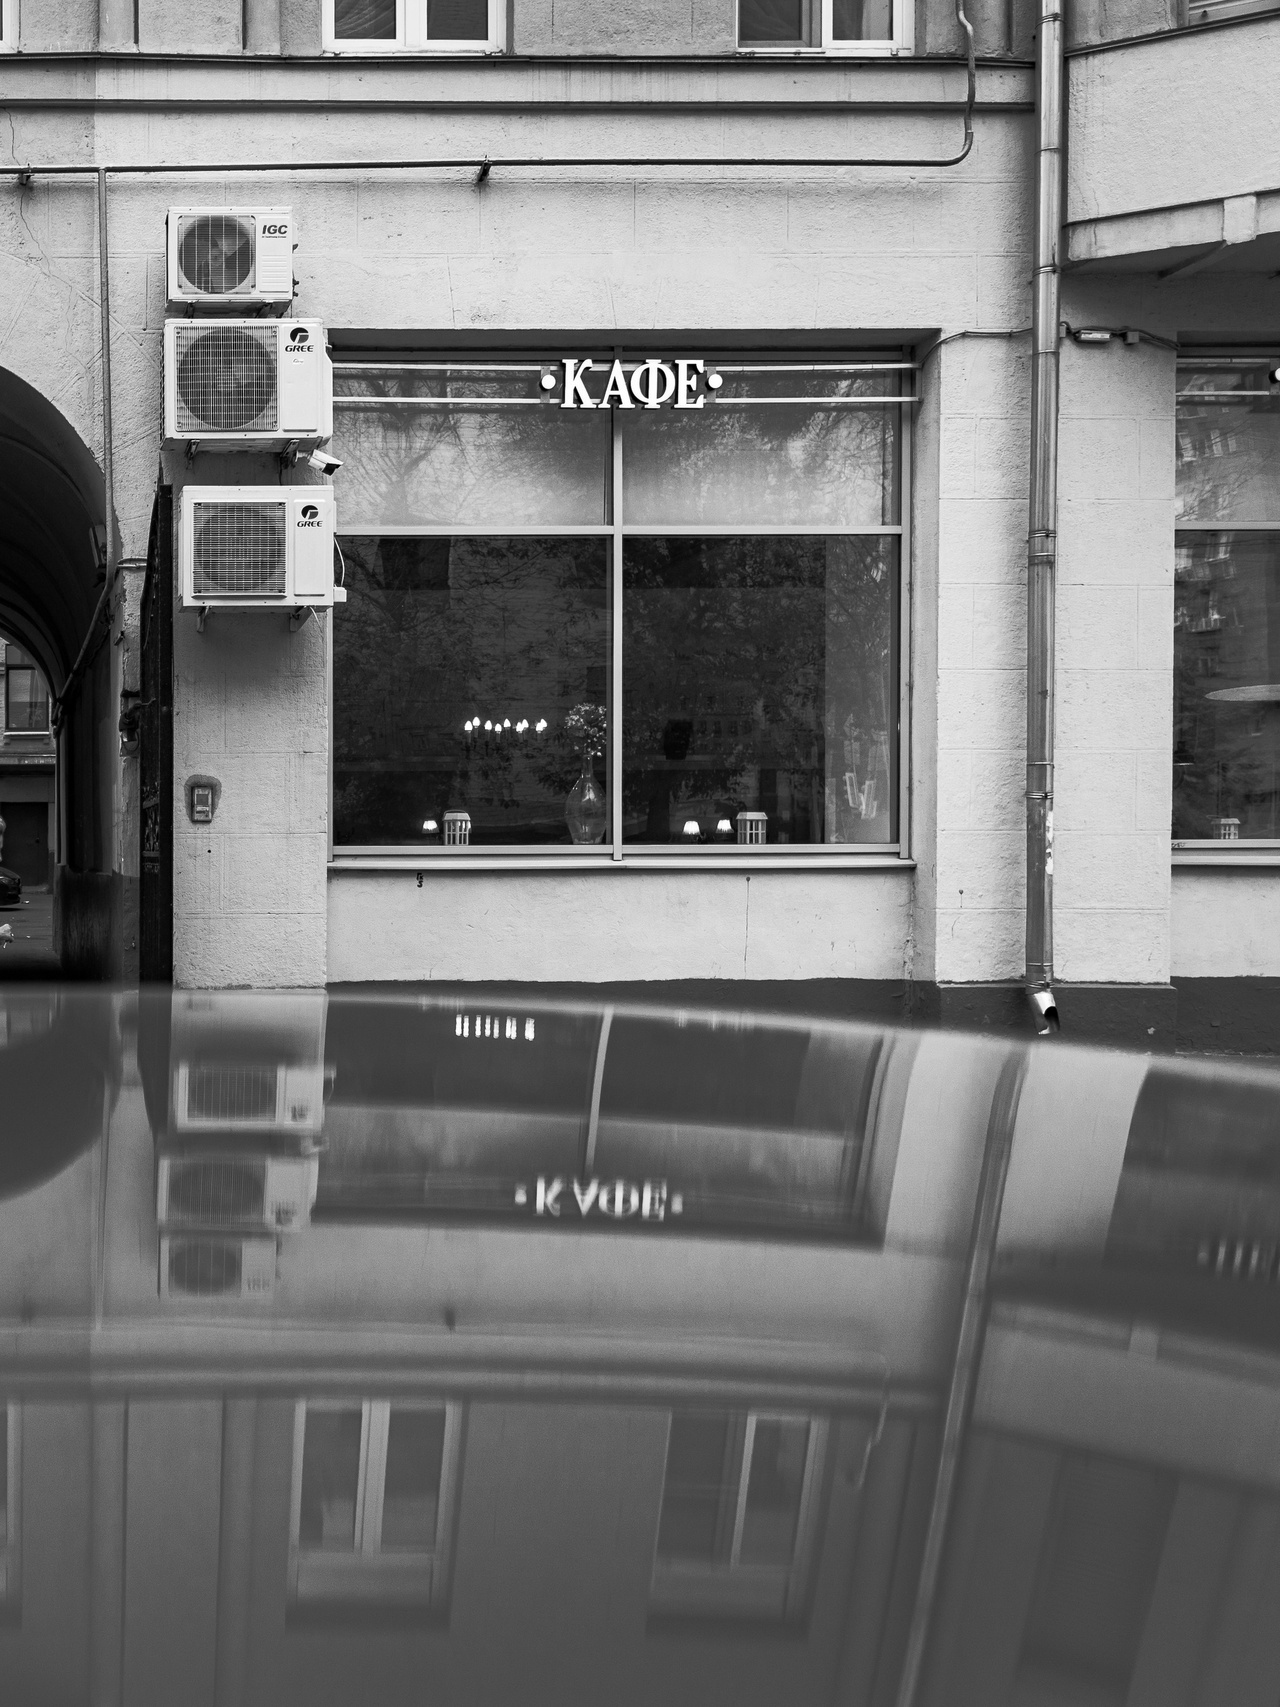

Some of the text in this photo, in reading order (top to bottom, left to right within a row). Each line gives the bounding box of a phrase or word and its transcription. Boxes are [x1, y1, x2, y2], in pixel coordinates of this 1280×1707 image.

[262, 224, 288, 235] IGC
[284, 344, 314, 353] GREE
[561, 358, 704, 409] КАФЕ
[296, 520, 323, 528] GREE
